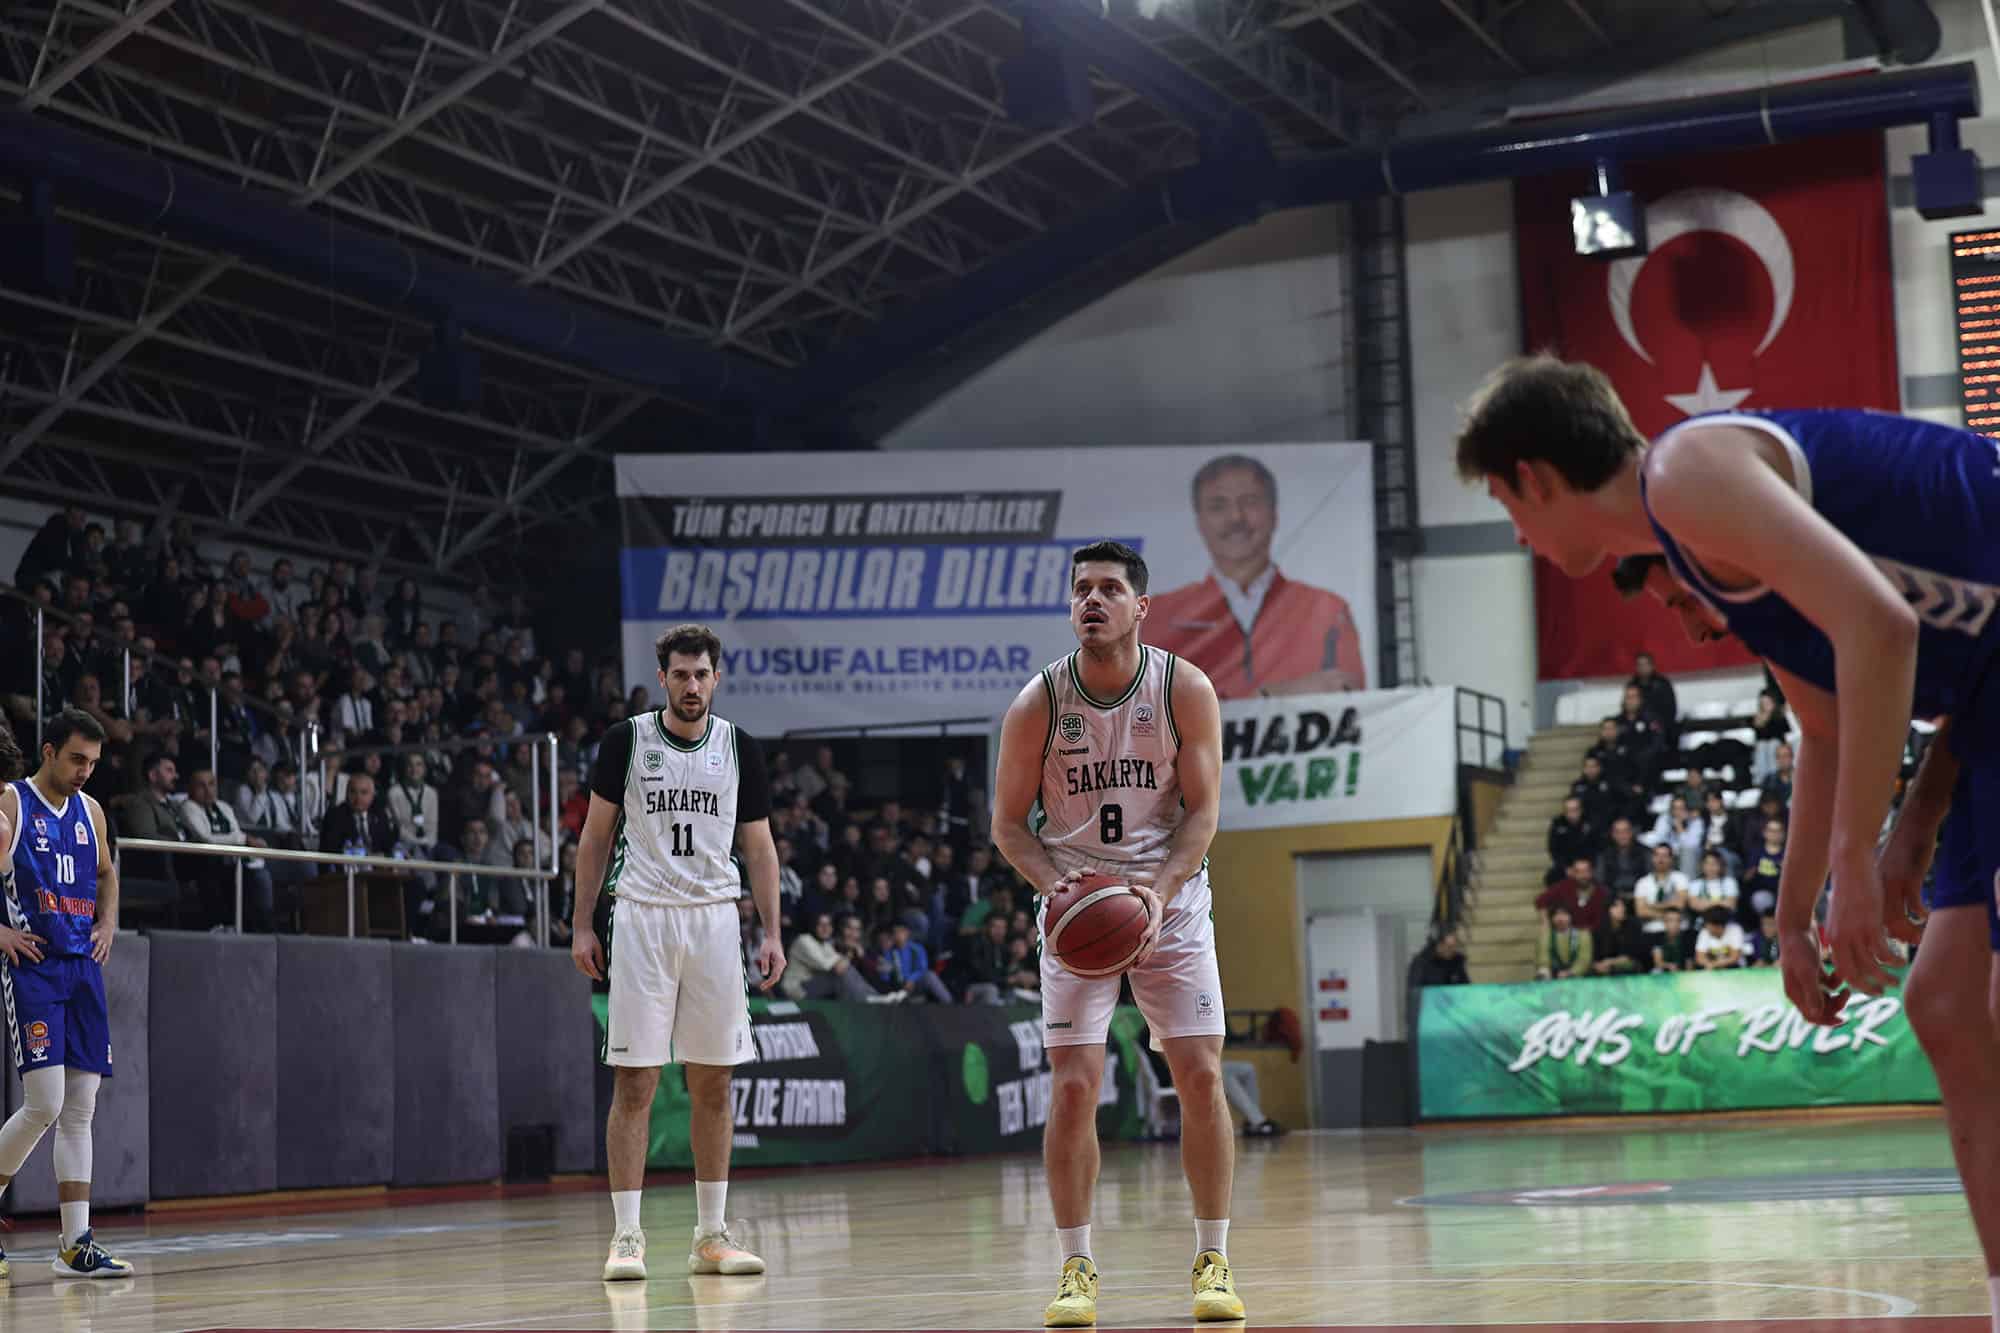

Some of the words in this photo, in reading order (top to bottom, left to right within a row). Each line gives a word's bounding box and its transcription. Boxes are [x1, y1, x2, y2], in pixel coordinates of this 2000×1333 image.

[672, 497, 725, 538] TÜM
[727, 503, 829, 538] SPORCU
[832, 503, 865, 537] VE
[865, 494, 1047, 536] ANTRENÖRLERE
[658, 549, 927, 623] BAŞARILAR
[932, 546, 1074, 609] DİLER
[1066, 759, 1158, 796] SAKARYA
[1238, 751, 1361, 807] VAR!
[646, 788, 720, 817] SAKARYA
[1100, 803, 1123, 844] 8
[671, 822, 695, 857] 11
[55, 852, 75, 885] 10
[1507, 1007, 1644, 1073] BOYS
[1653, 1006, 1737, 1056] OF
[1736, 993, 1901, 1057] RIVER
[754, 1078, 781, 1127] DE
